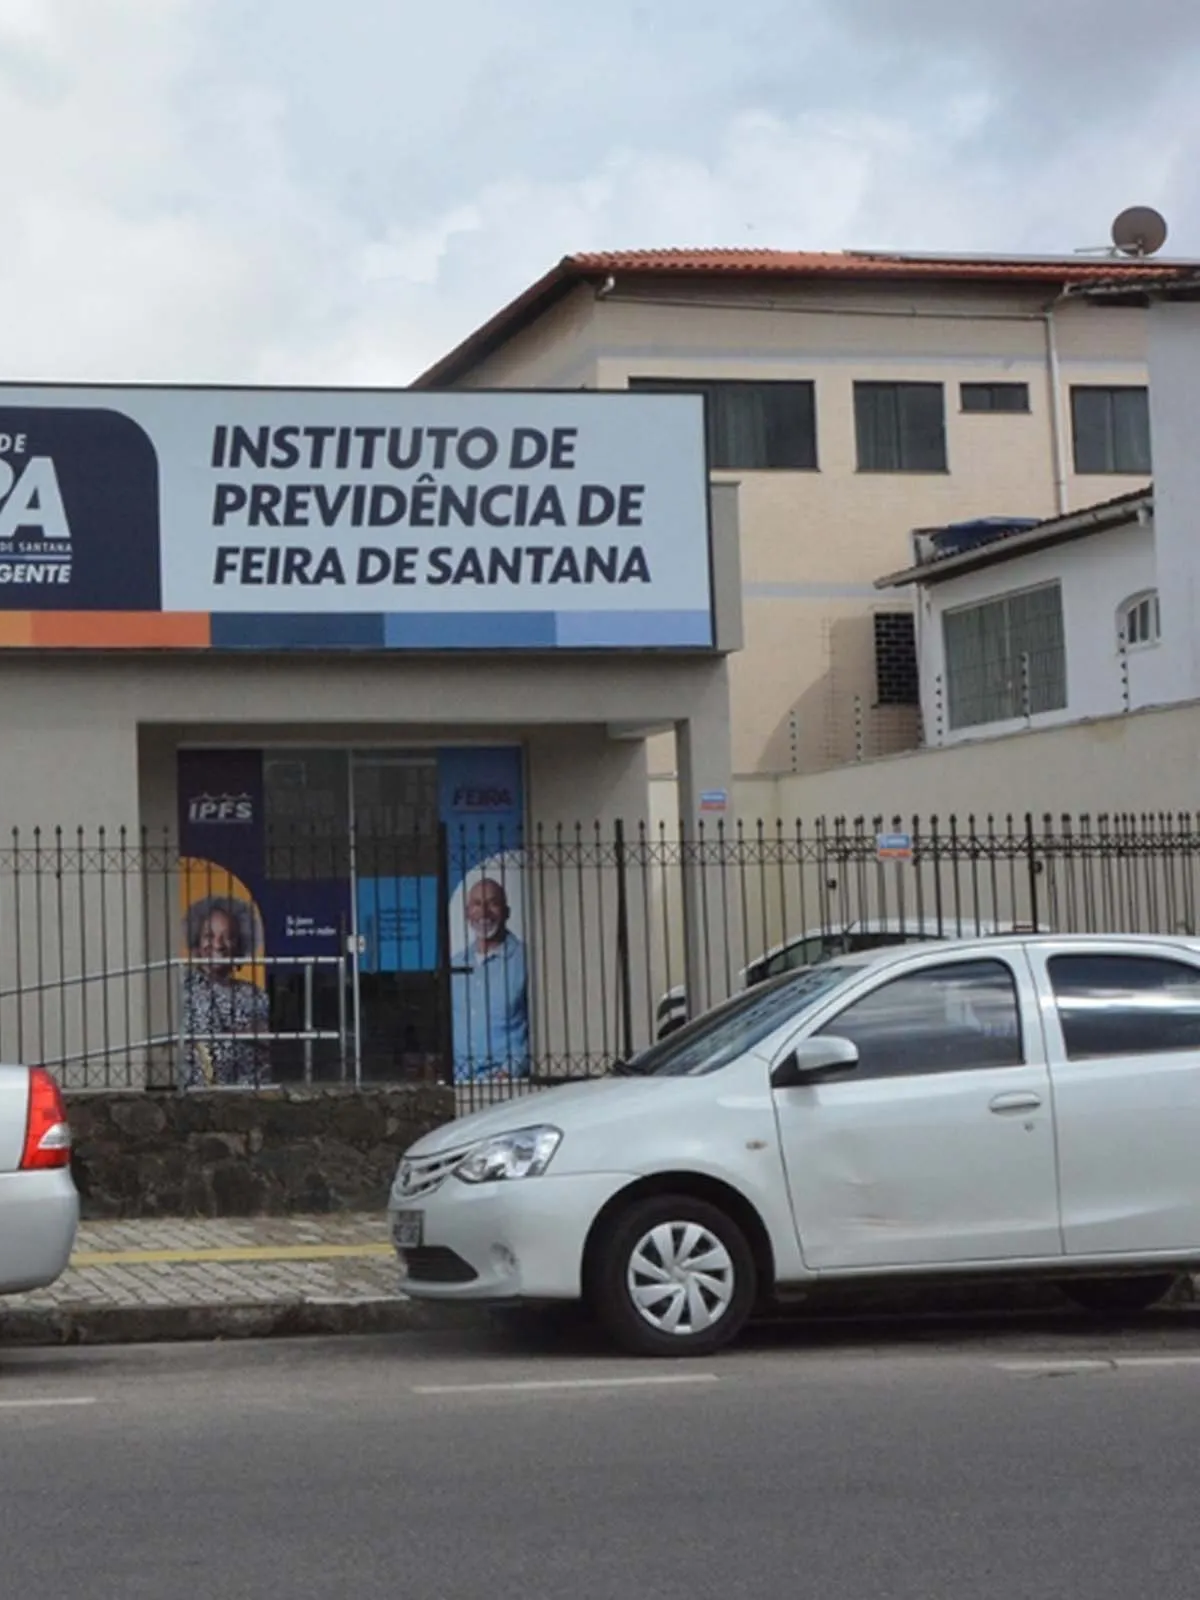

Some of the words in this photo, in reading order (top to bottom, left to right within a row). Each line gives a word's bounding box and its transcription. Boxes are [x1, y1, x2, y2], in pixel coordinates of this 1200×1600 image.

[211, 425, 498, 470] INSTITUTO
[509, 427, 578, 469] DE
[212, 474, 566, 528] PREVIDÊNCIA
[577, 485, 646, 527] DE
[18, 541, 73, 553] SANTANA
[213, 546, 346, 585] FEIRA
[356, 547, 418, 585] DE
[426, 546, 652, 585] SANTANA
[189, 801, 253, 821] IPFS
